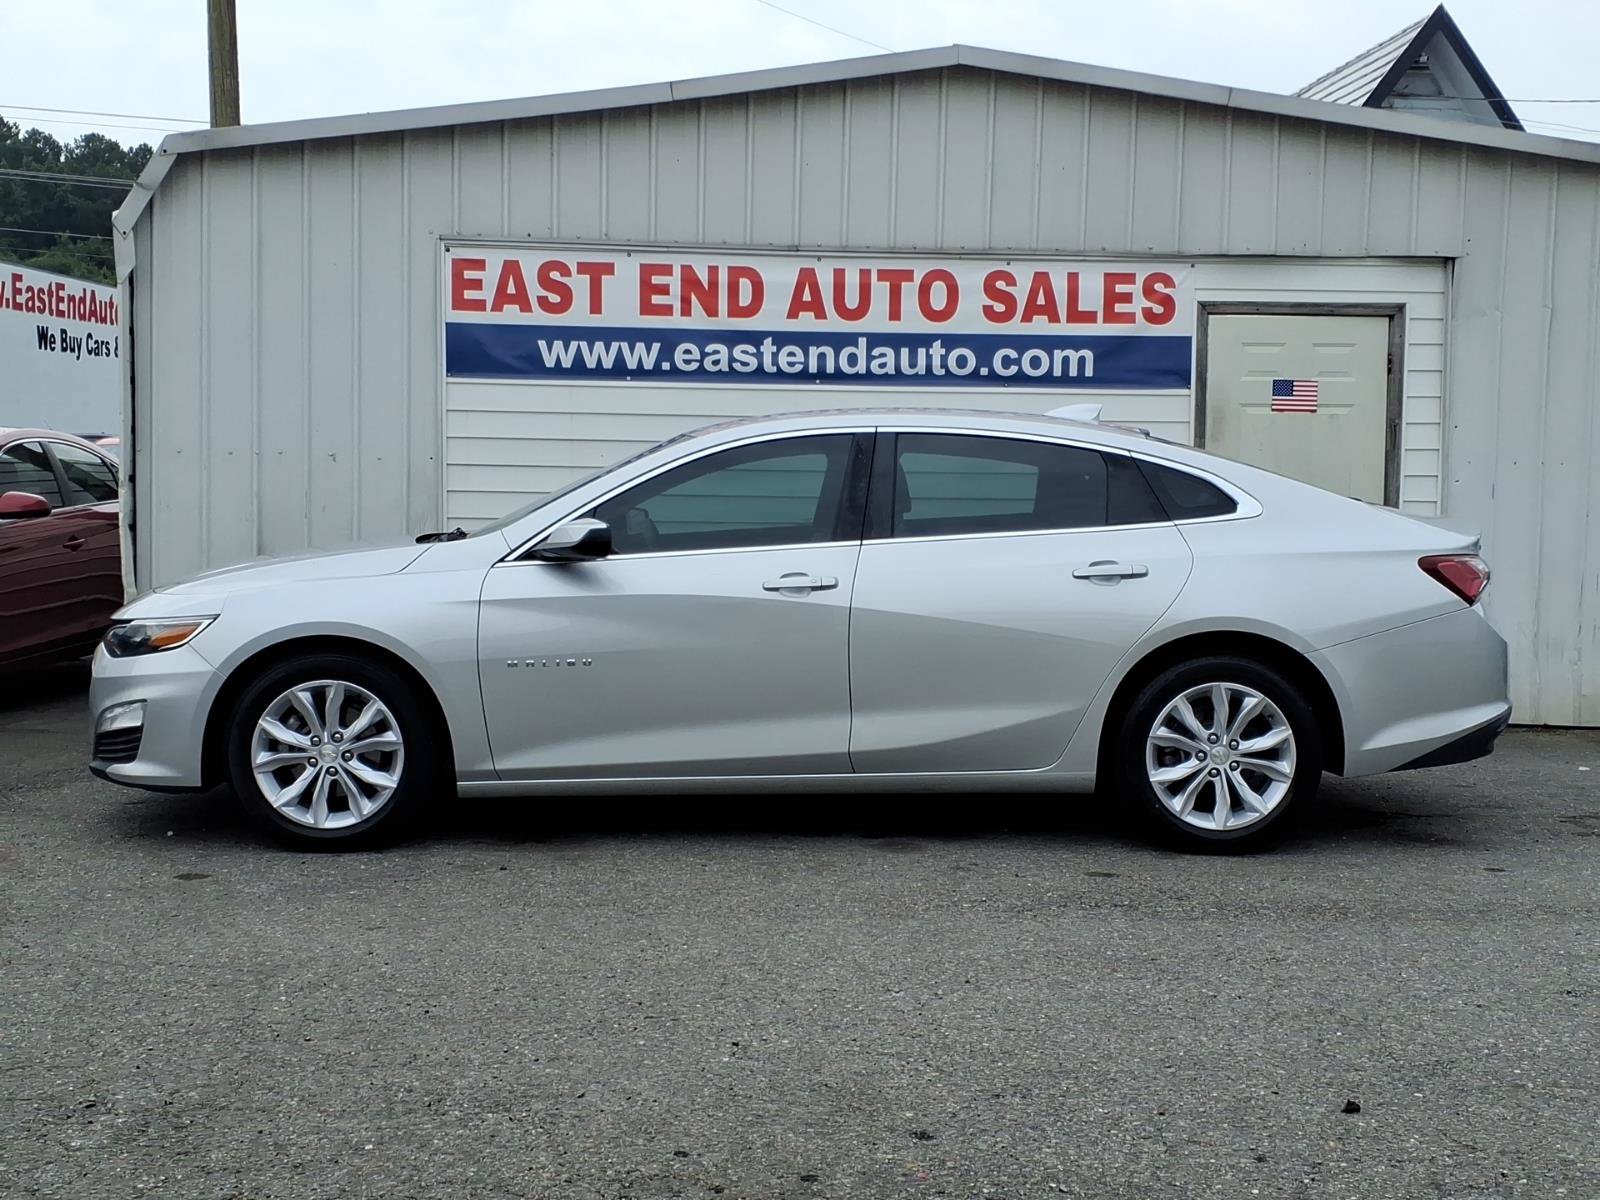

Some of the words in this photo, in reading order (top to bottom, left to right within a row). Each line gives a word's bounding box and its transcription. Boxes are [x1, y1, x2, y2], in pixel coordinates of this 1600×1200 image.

[0, 272, 118, 326] .EastEndAut
[451, 258, 616, 315] EAST
[639, 263, 765, 319] END
[786, 267, 959, 323] AUTO
[982, 270, 1177, 325] SALES
[37, 325, 56, 352] We
[60, 328, 82, 360] Buy
[86, 332, 111, 358] Cars
[537, 336, 1094, 377] www.eastendauto.com
[507, 658, 592, 668] MALIBU
